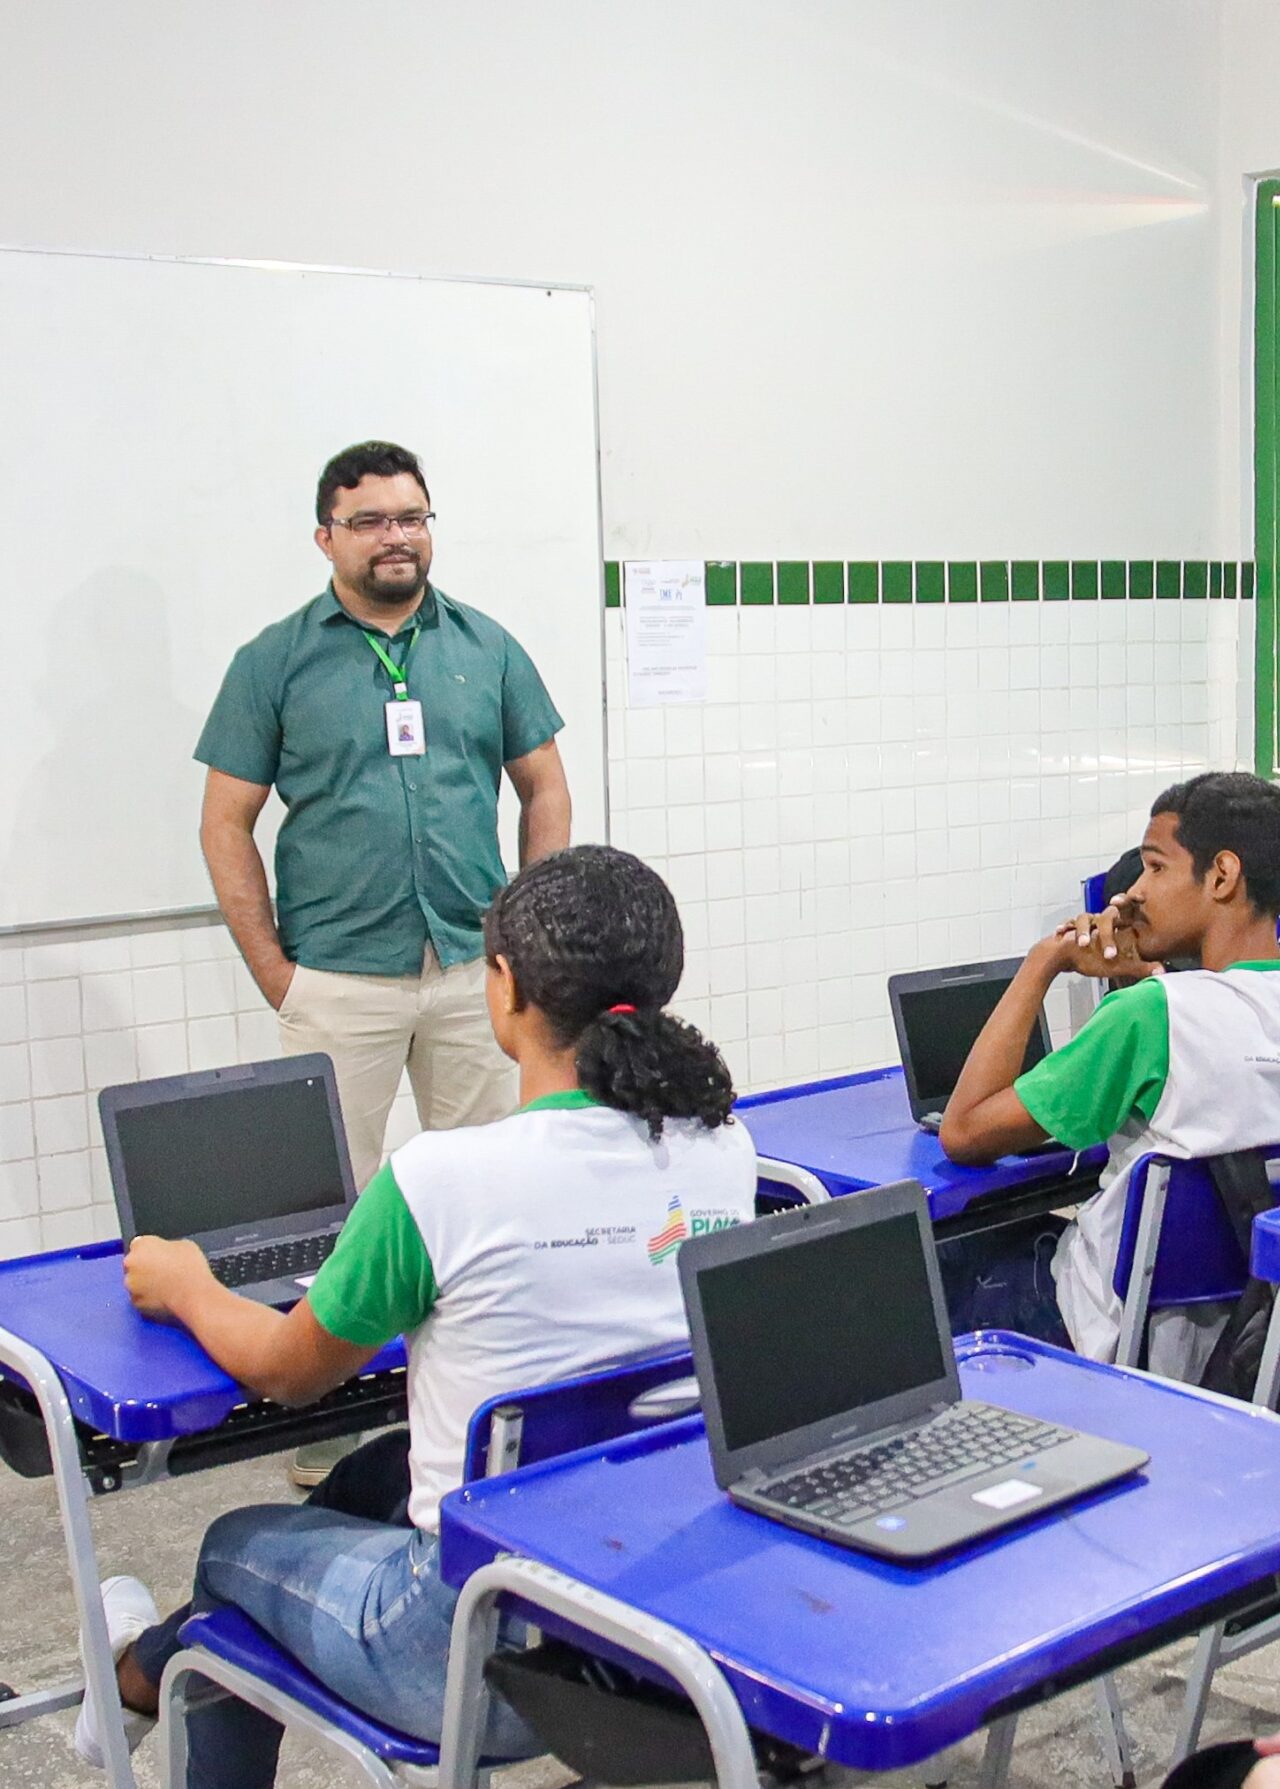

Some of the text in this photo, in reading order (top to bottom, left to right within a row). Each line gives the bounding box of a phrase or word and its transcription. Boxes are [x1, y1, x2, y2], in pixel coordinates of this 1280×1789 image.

[585, 1226, 636, 1237] SECRETARIA
[534, 1241, 548, 1249] DA
[551, 1236, 598, 1249] EDUCAÇÃO
